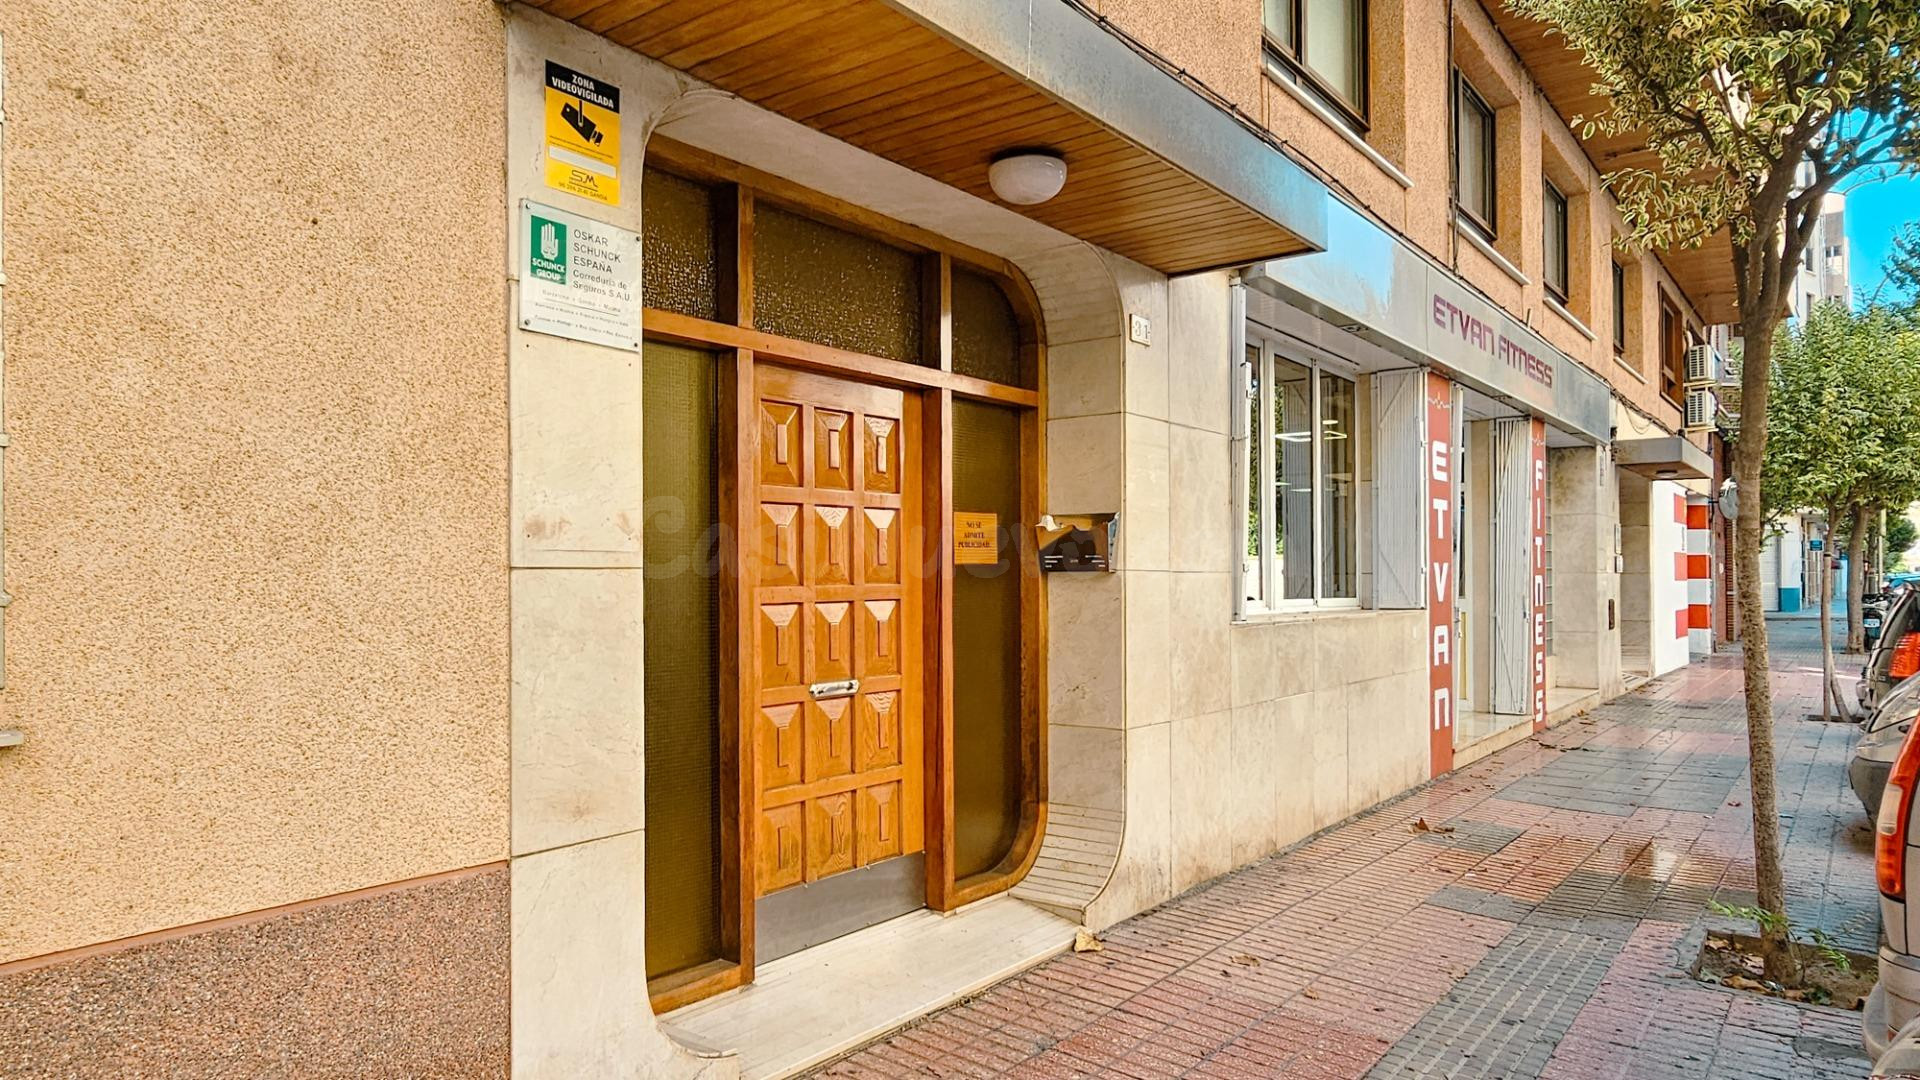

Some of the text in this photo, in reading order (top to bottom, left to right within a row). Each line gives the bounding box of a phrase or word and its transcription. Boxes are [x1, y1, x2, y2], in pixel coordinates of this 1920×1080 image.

[572, 73, 595, 91] ZONA
[551, 76, 614, 108] VIDEOVIGILADA
[573, 229, 608, 246] OSKAR
[573, 242, 621, 263] SCHUNCK
[532, 257, 566, 273] SCHUNCK
[573, 255, 613, 273] ESPAÑA
[536, 268, 562, 281] GROUP
[573, 280, 607, 296] Seguros
[617, 281, 628, 290] de
[1433, 293, 1553, 389] ETVAN FITNESS
[1432, 440, 1451, 731] ETVAN
[1534, 458, 1545, 724] FITNESS
